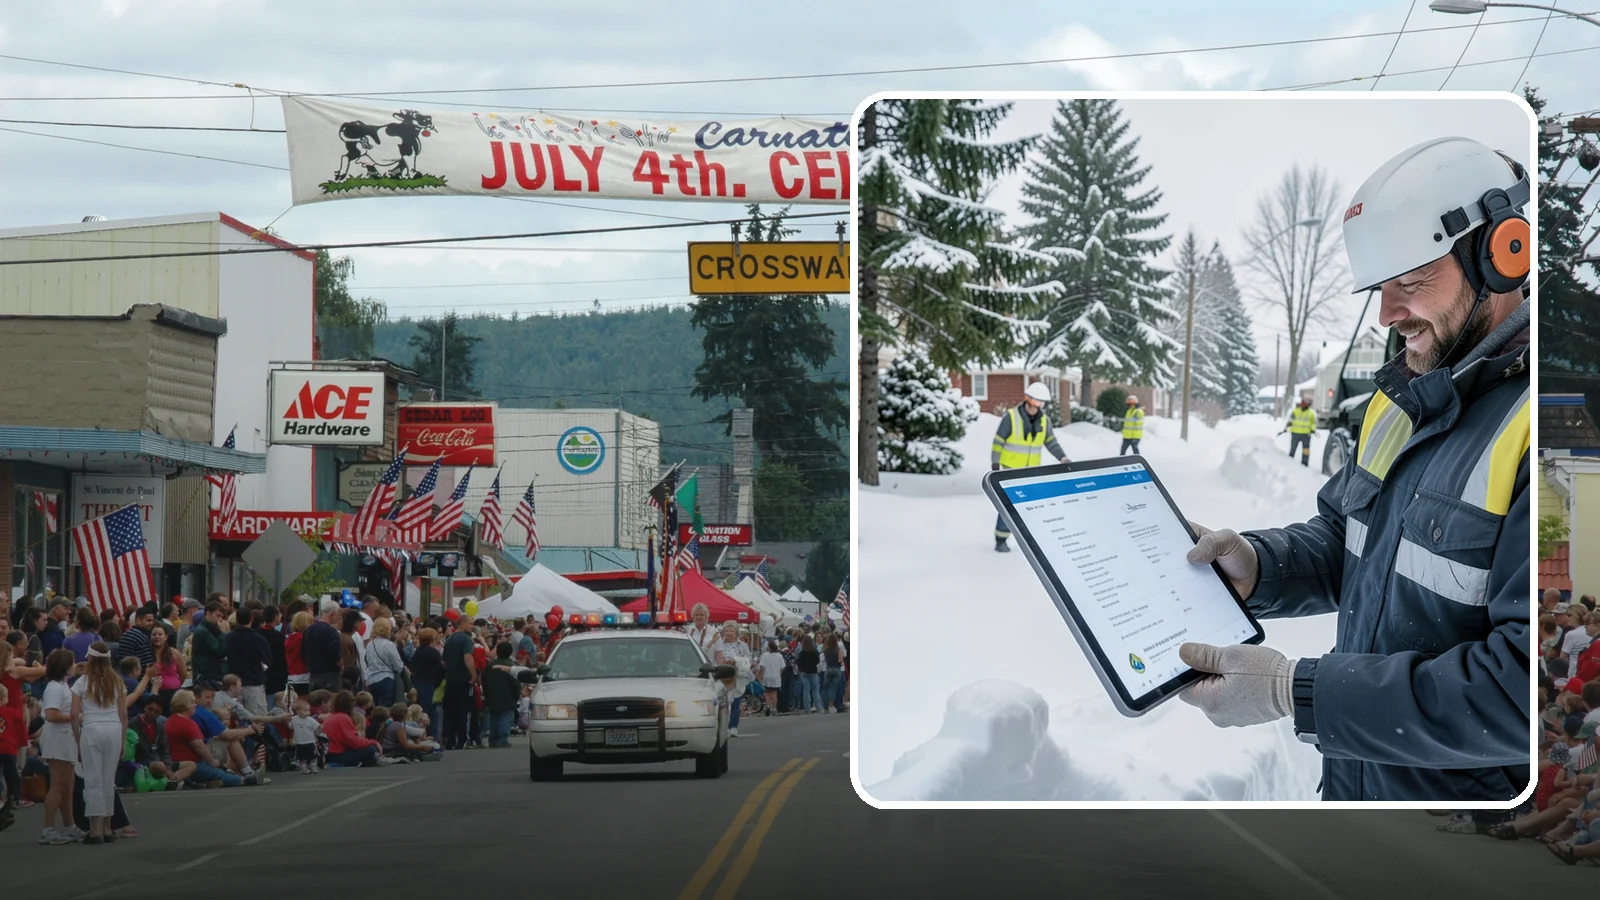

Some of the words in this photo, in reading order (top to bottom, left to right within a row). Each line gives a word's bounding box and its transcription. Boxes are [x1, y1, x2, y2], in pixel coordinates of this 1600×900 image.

[481, 141, 605, 192] JULY
[632, 150, 747, 198] 4th.
[697, 254, 850, 280] CROSSWA
[282, 380, 374, 420] ACE
[405, 409, 453, 422] CEDAR
[283, 421, 371, 437] Hardware
[416, 427, 478, 447] Coca-Cola
[353, 466, 385, 481] Simpl
[83, 485, 94, 494] St.
[95, 485, 124, 495] Vincent
[126, 486, 136, 495] de
[137, 486, 155, 496] Paul
[699, 535, 731, 543] GLASS
